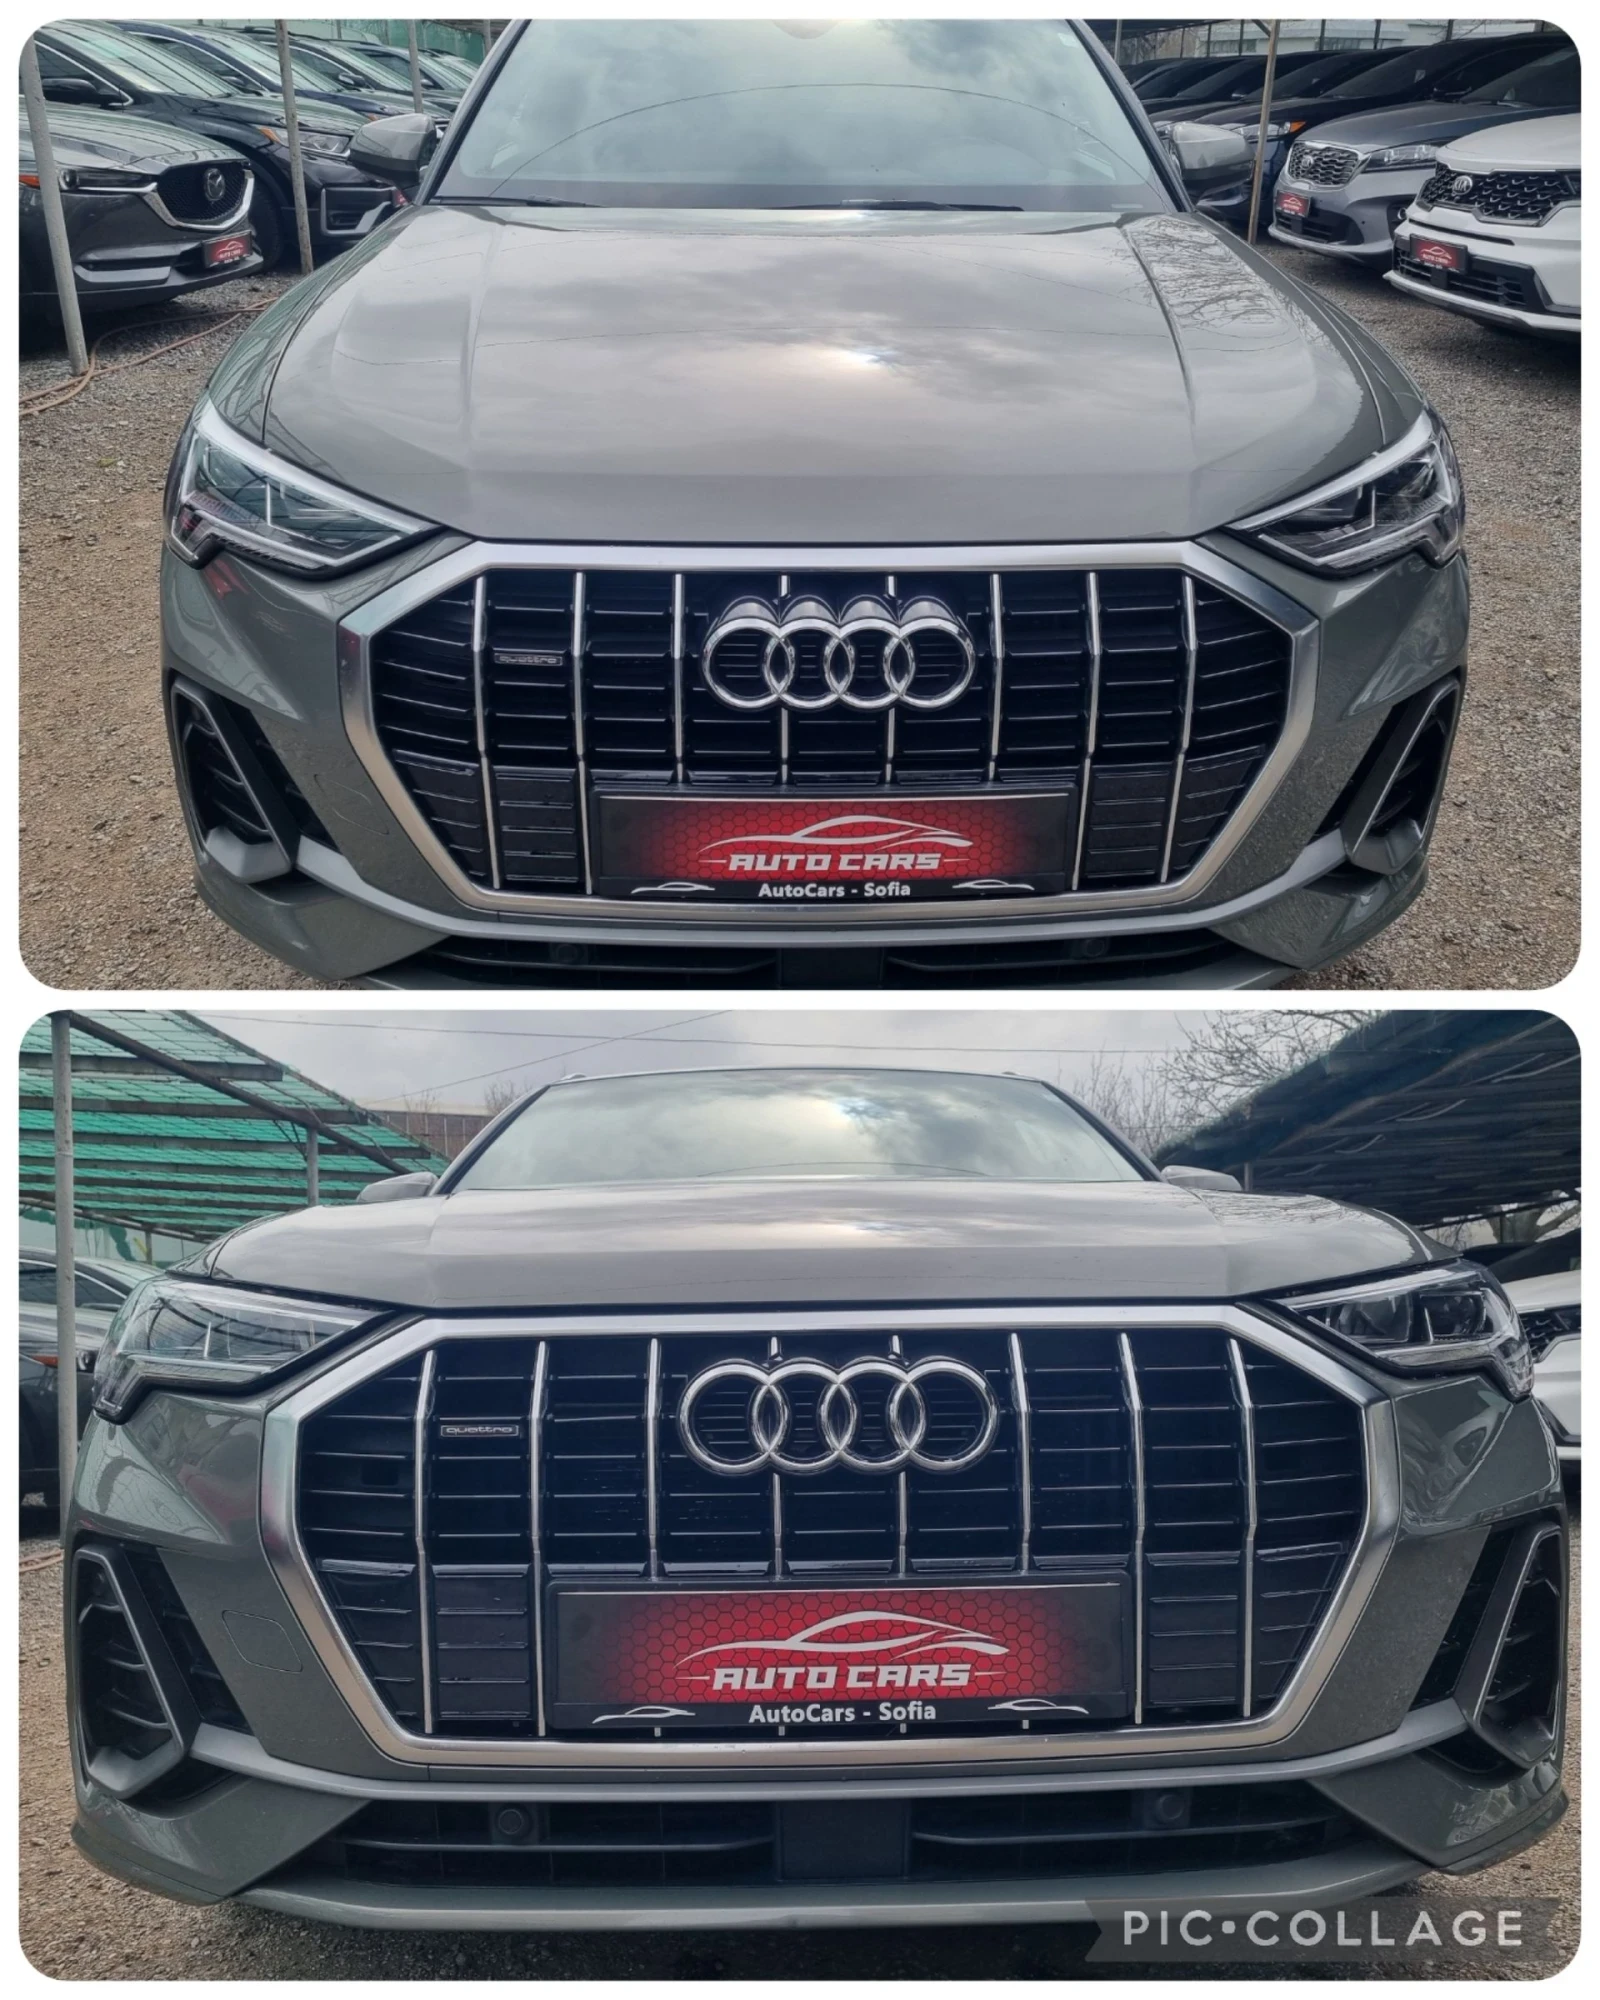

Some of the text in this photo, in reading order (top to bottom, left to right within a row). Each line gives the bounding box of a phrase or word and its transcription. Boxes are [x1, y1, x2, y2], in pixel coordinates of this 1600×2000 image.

[499, 655, 557, 664] quattro
[728, 853, 943, 872] AUTO CARS
[758, 882, 845, 898] AutoCars
[863, 880, 911, 897] Sofia
[446, 1426, 513, 1436] quattro
[712, 1663, 972, 1691] AUTO CARS
[748, 1703, 856, 1724] AutoCars
[878, 1701, 937, 1721] Sofia
